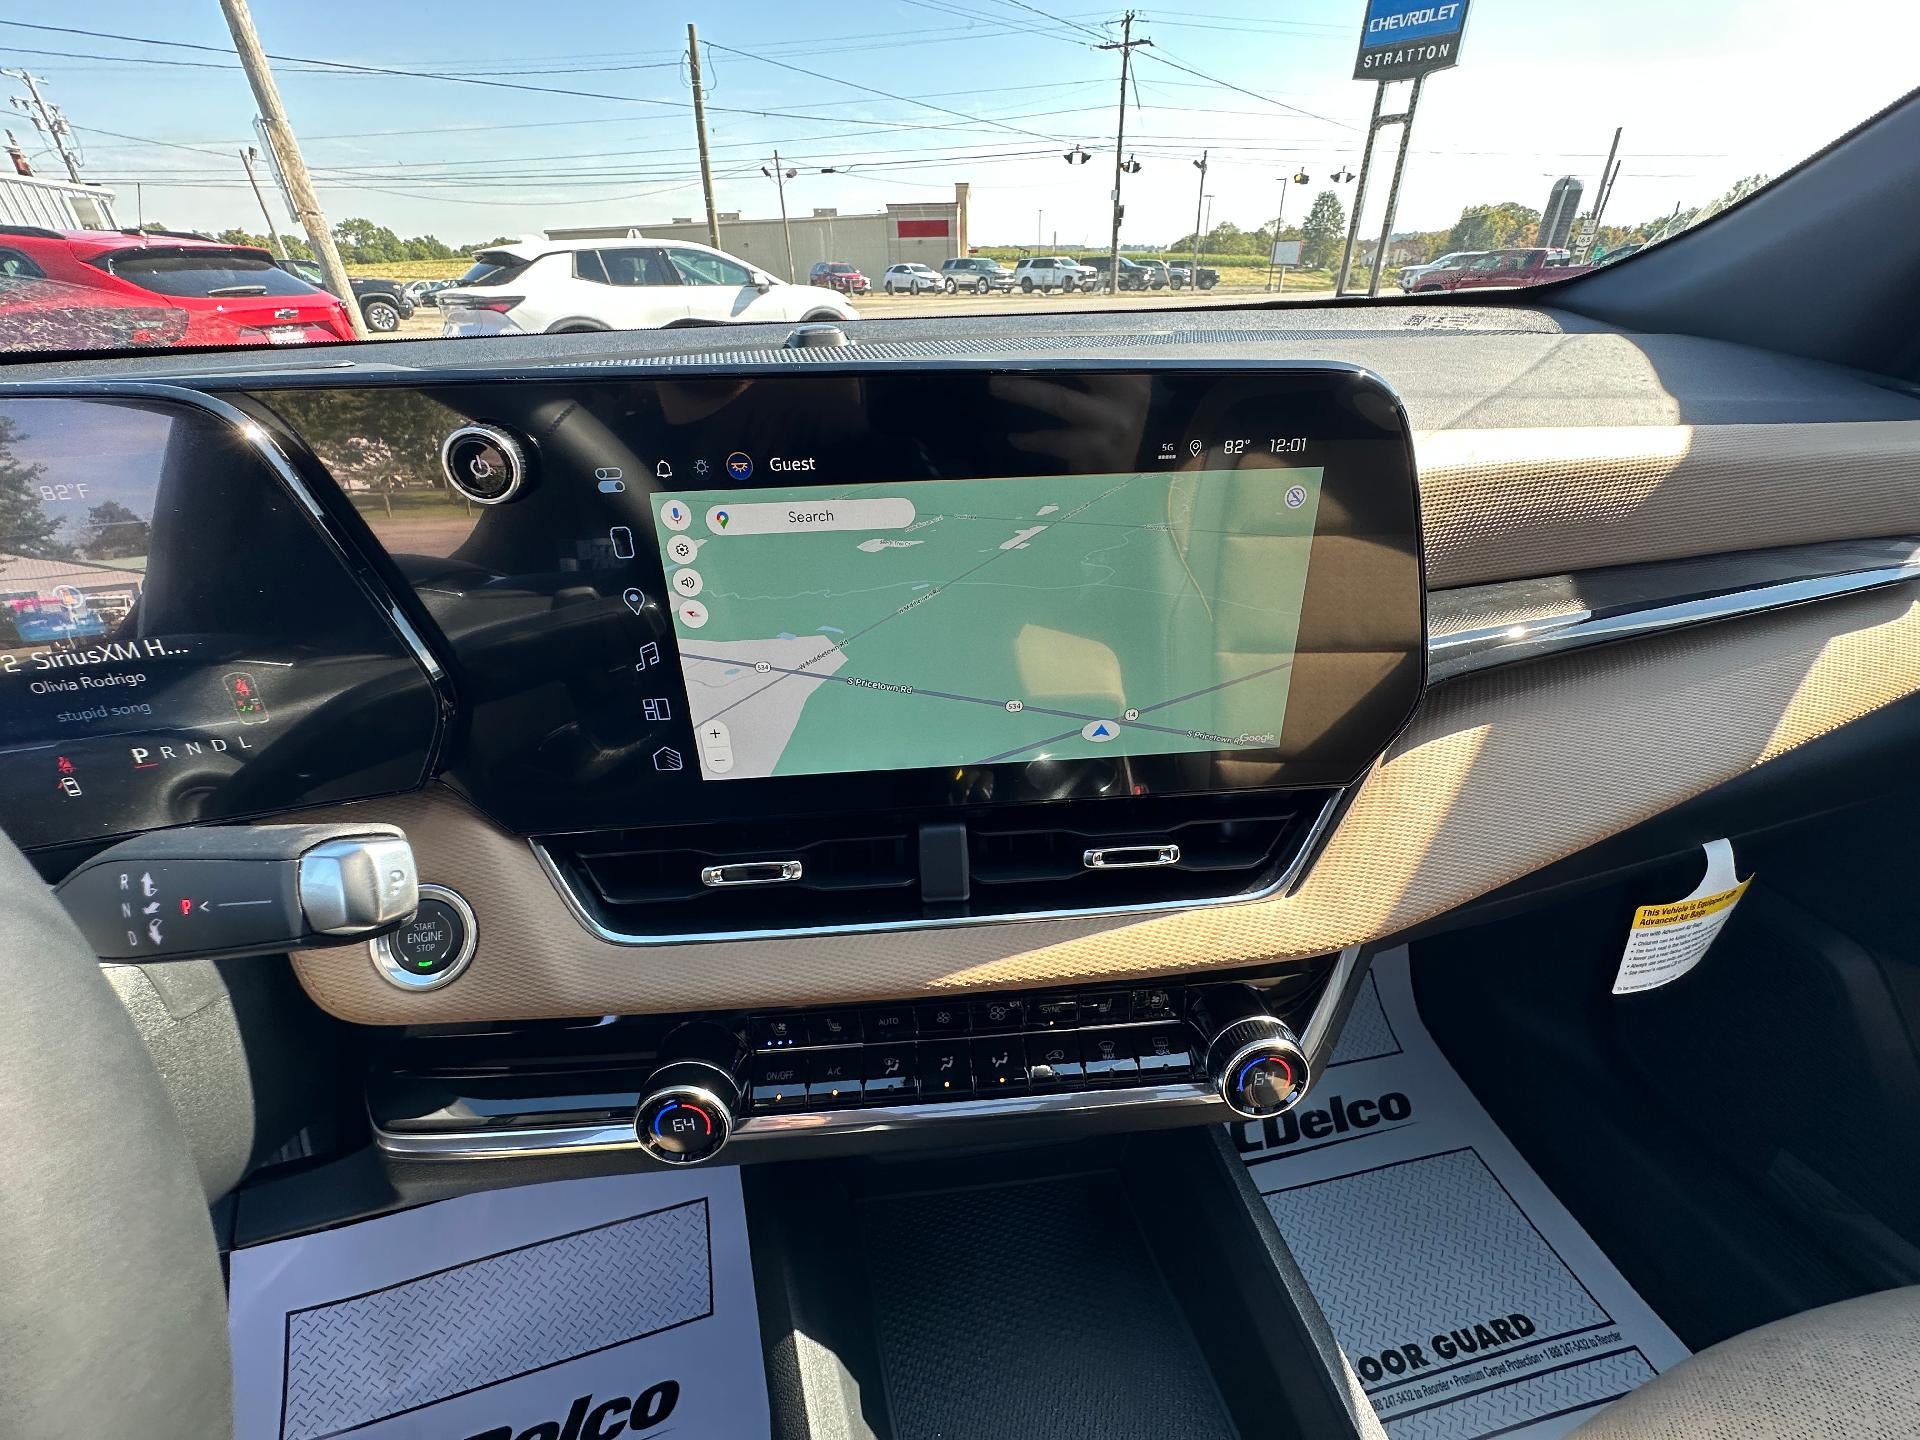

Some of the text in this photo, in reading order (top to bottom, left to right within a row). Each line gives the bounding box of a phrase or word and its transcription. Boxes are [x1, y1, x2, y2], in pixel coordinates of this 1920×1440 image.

[1369, 3, 1460, 33] CHEVROLET
[1363, 44, 1450, 68] STRATTON
[1161, 442, 1175, 452] 5G
[1269, 437, 1308, 453] 12:01
[769, 456, 817, 473] Guest
[787, 508, 835, 524] Search
[0, 638, 189, 673] 2 SiriusXM H...
[30, 670, 148, 695] Olivia Rodrigo
[847, 677, 913, 695] S Pricetown Rd
[57, 701, 153, 724] stupid song
[1008, 702, 1021, 711] 534
[1126, 710, 1137, 719] 14
[1240, 731, 1275, 743] Google
[132, 735, 253, 765] P R N D L
[120, 873, 129, 890] R
[121, 902, 131, 918] N
[181, 899, 192, 915] P
[1643, 908, 1660, 917] This
[1661, 905, 1688, 915] Vehicle
[413, 921, 437, 931] START
[1640, 915, 1678, 926] Advanced
[127, 930, 138, 946] D
[407, 930, 444, 944] ENGINE
[416, 943, 436, 953] STOP
[878, 1016, 899, 1027] AUTO
[766, 1070, 794, 1081] ON/OFF
[827, 1066, 842, 1076] A/C
[672, 1117, 697, 1132] 64
[1358, 1313, 1536, 1385] OOR GUARD
[1421, 1381, 1451, 1398] Reorder
[1453, 1370, 1486, 1388] Premium
[1483, 1362, 1507, 1379] Carpet
[1506, 1352, 1542, 1372] Protection
